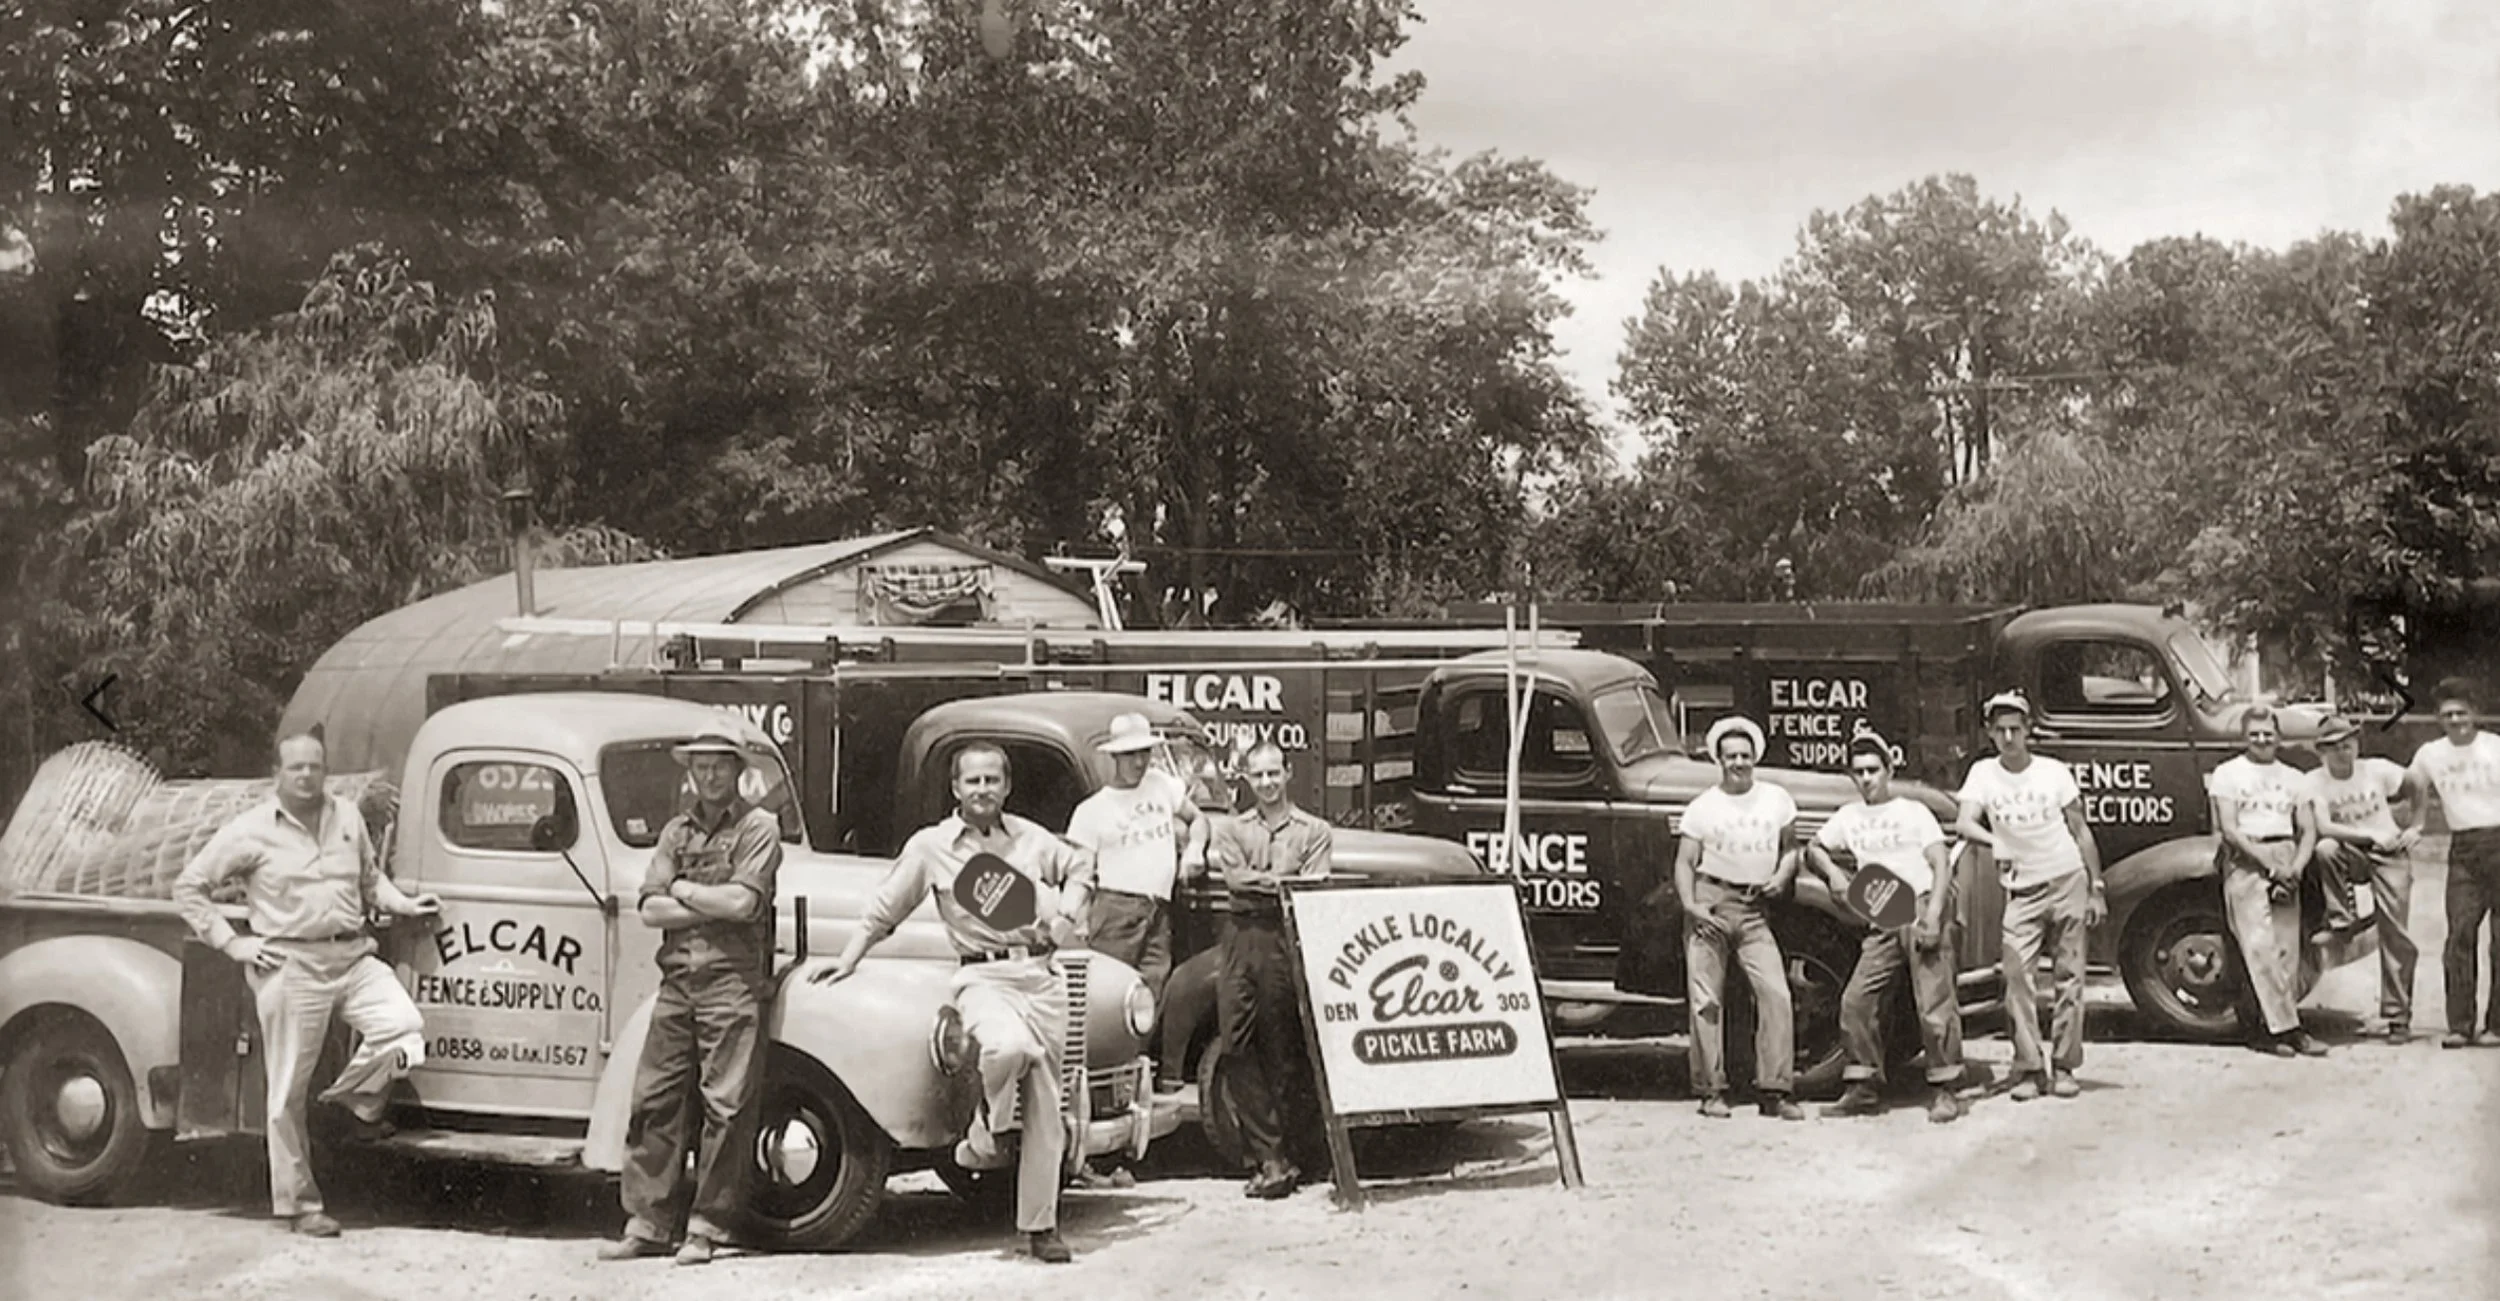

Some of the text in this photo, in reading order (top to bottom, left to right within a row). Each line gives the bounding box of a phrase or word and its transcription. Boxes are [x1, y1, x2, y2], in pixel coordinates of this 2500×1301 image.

[1148, 673, 1283, 711] ELCAR
[1770, 679, 1868, 708] ELCAR
[1278, 723, 1308, 750] CO.
[1769, 714, 1842, 736] FENCE
[2074, 760, 2152, 790] ENCE
[2084, 795, 2175, 824] ECTORS
[1466, 831, 1588, 874] FENCE
[1521, 878, 1601, 907] TORS
[434, 919, 583, 976] ELCAR
[1328, 912, 1515, 990] PICKLE LOCALLY
[417, 974, 476, 1007] FENCE
[1368, 953, 1484, 1023] Elcar
[1496, 992, 1531, 1012] 303
[1324, 1002, 1359, 1022] DEN
[1363, 1027, 1507, 1058] PICKLE FARM
